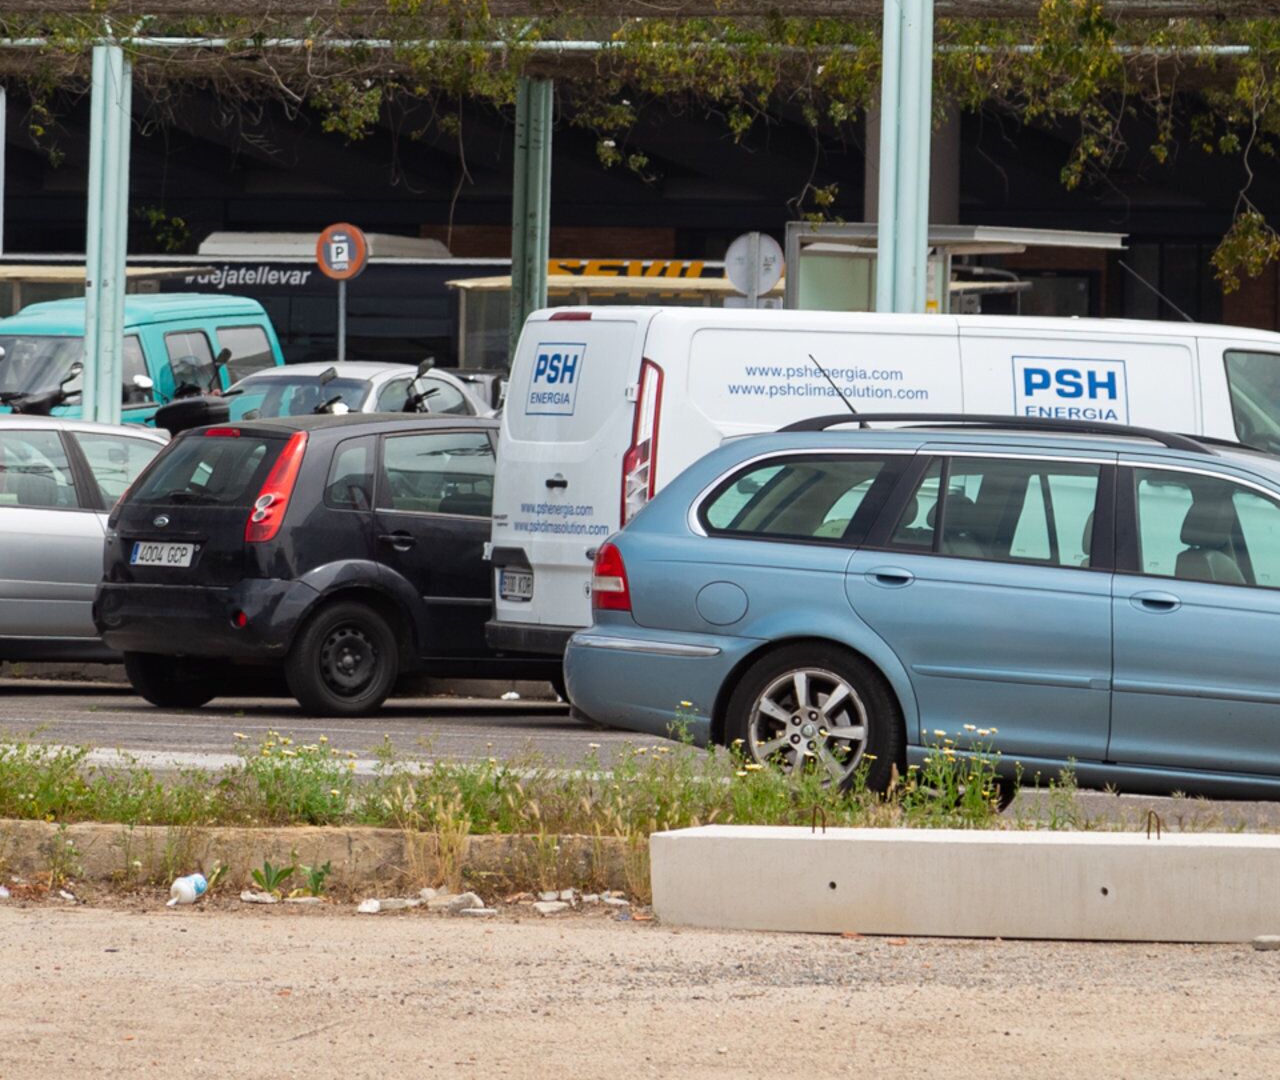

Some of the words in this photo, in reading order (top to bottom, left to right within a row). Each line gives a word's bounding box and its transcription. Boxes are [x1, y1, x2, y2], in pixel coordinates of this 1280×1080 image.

[533, 353, 579, 384] PSH
[745, 365, 904, 382] www.pshenergia.com
[728, 382, 929, 400] www.pshclimasolution.com
[1023, 367, 1118, 400] PSH
[530, 391, 570, 404] ENERGIA
[1024, 405, 1119, 421] ENERGIA
[520, 501, 594, 518] www.pshenergia.com
[138, 544, 164, 563] 4004
